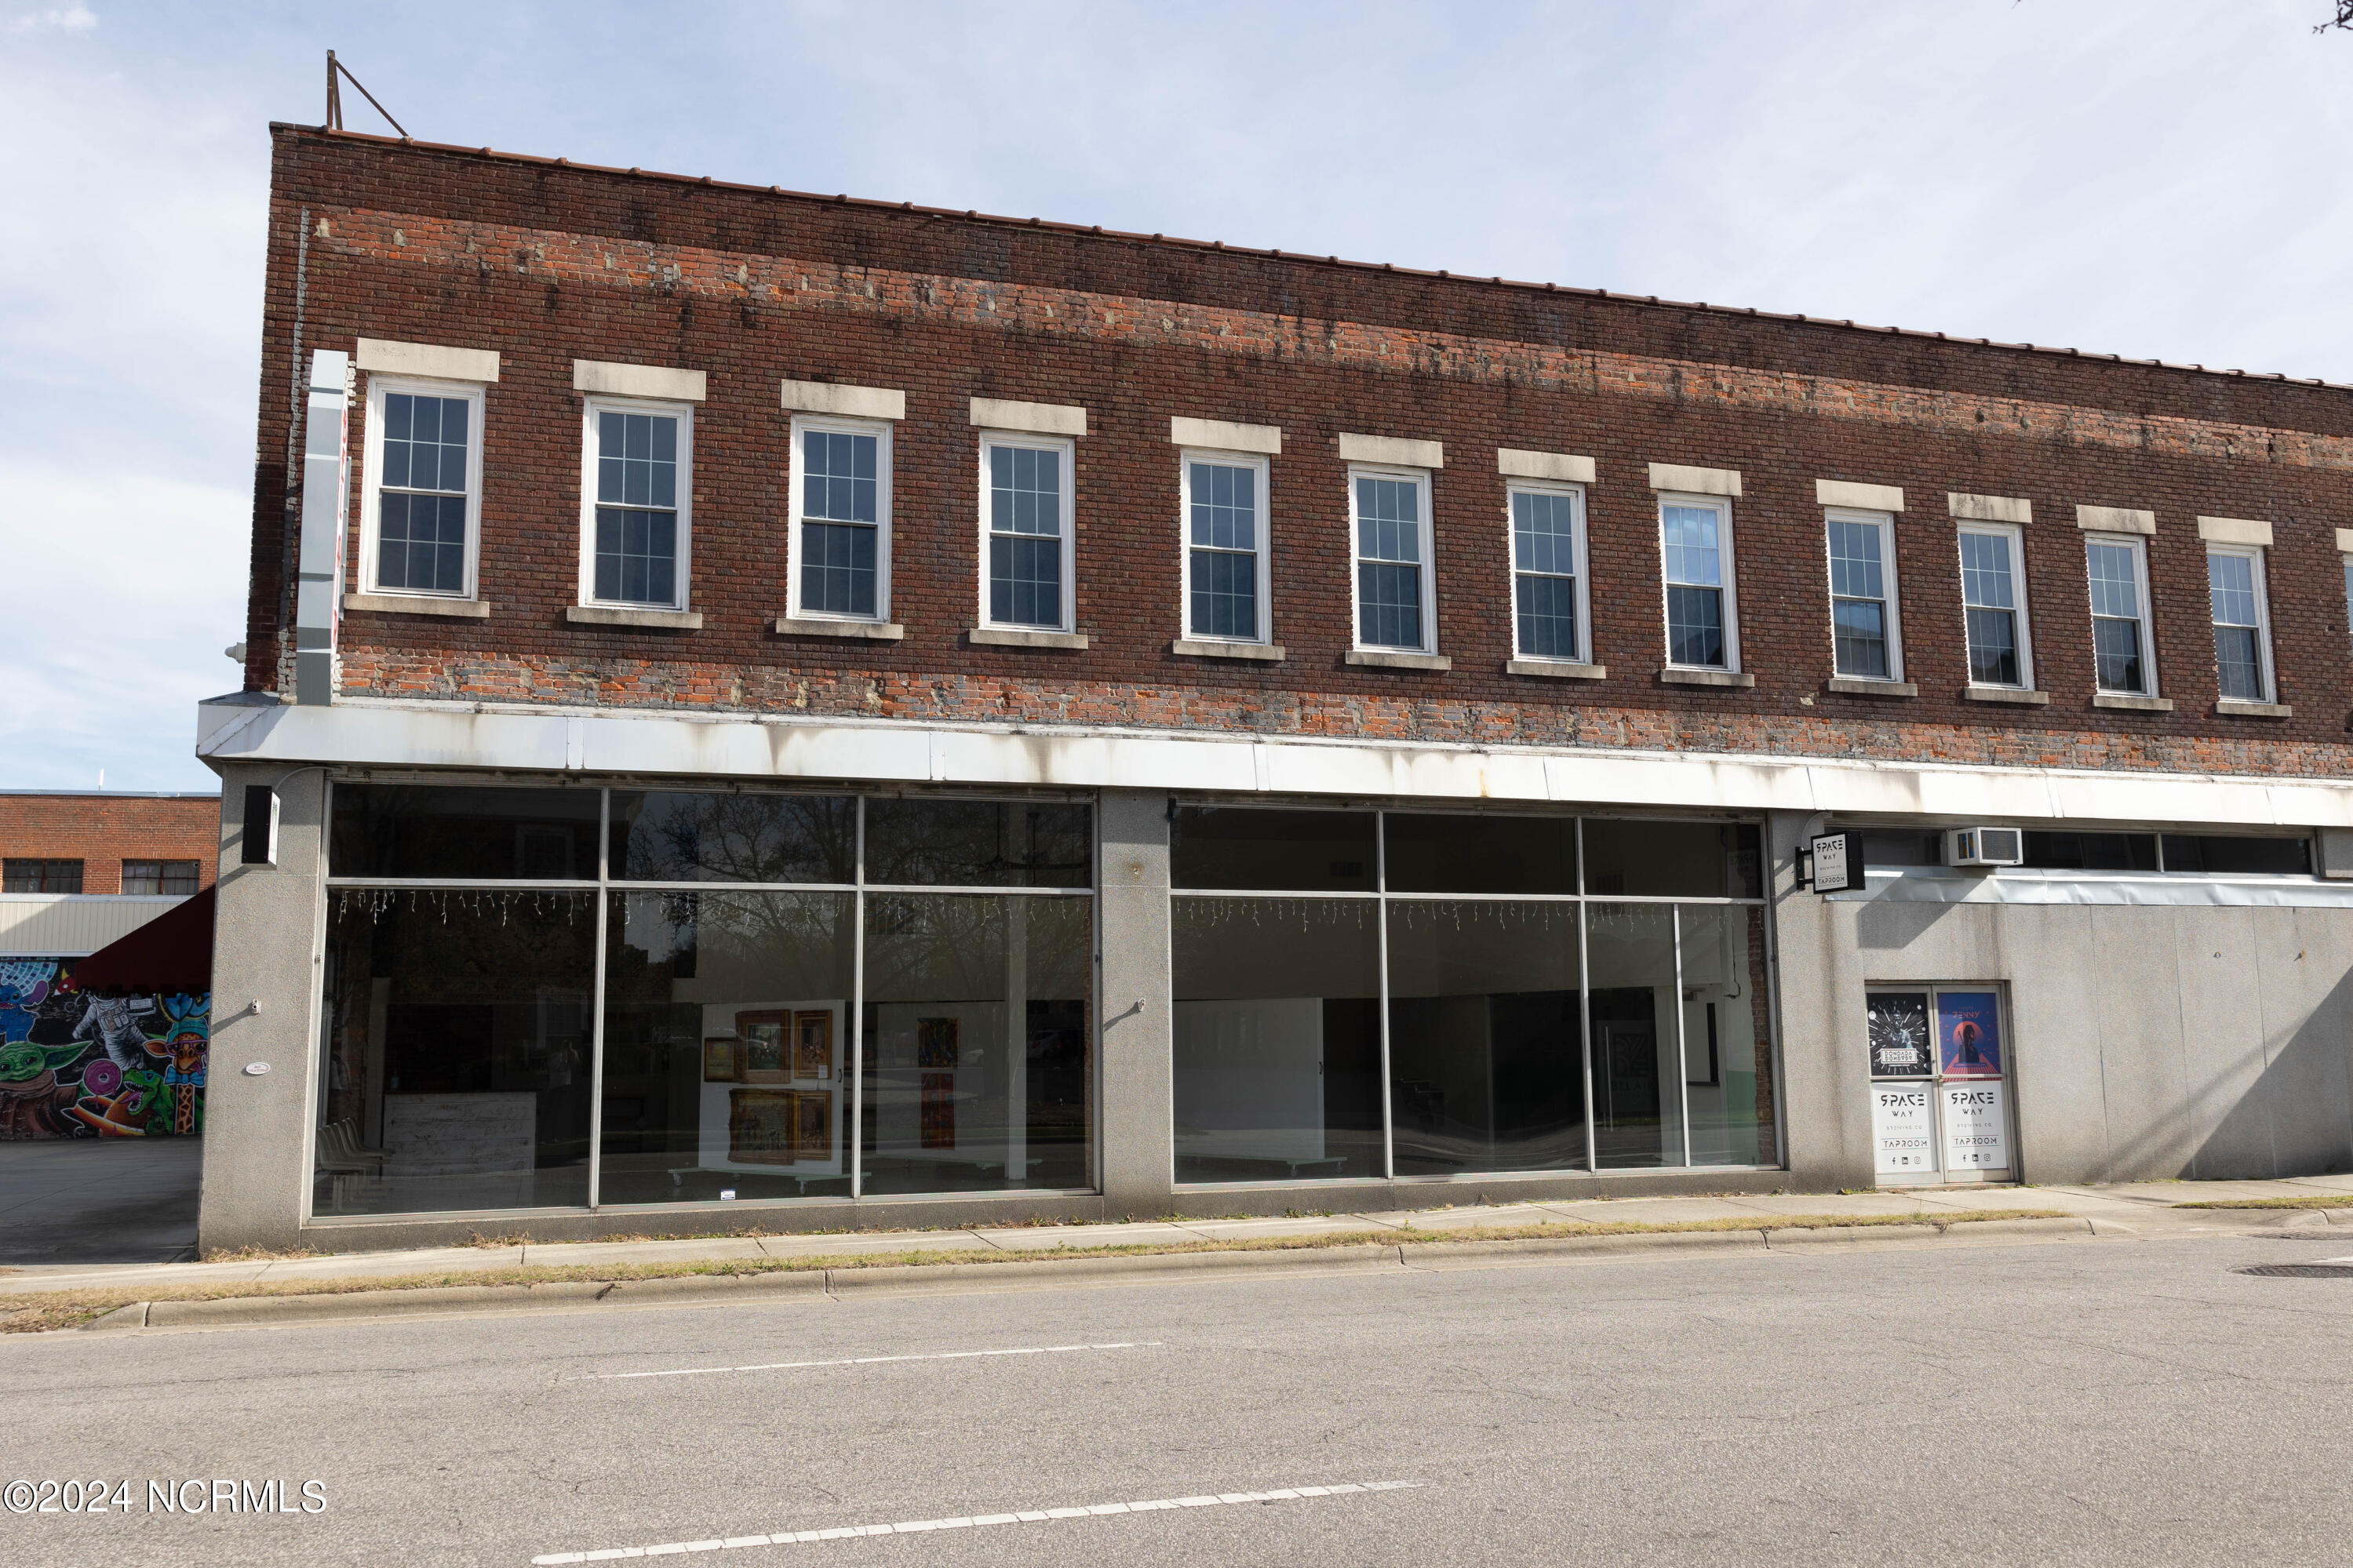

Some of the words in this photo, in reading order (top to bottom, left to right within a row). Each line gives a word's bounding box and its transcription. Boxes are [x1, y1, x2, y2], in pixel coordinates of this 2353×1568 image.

[1816, 840, 1844, 853] SPACE
[1818, 876, 1845, 885] TAPROOM
[1881, 1093, 1925, 1107] SPACE
[1951, 1092, 1994, 1104] SPACE
